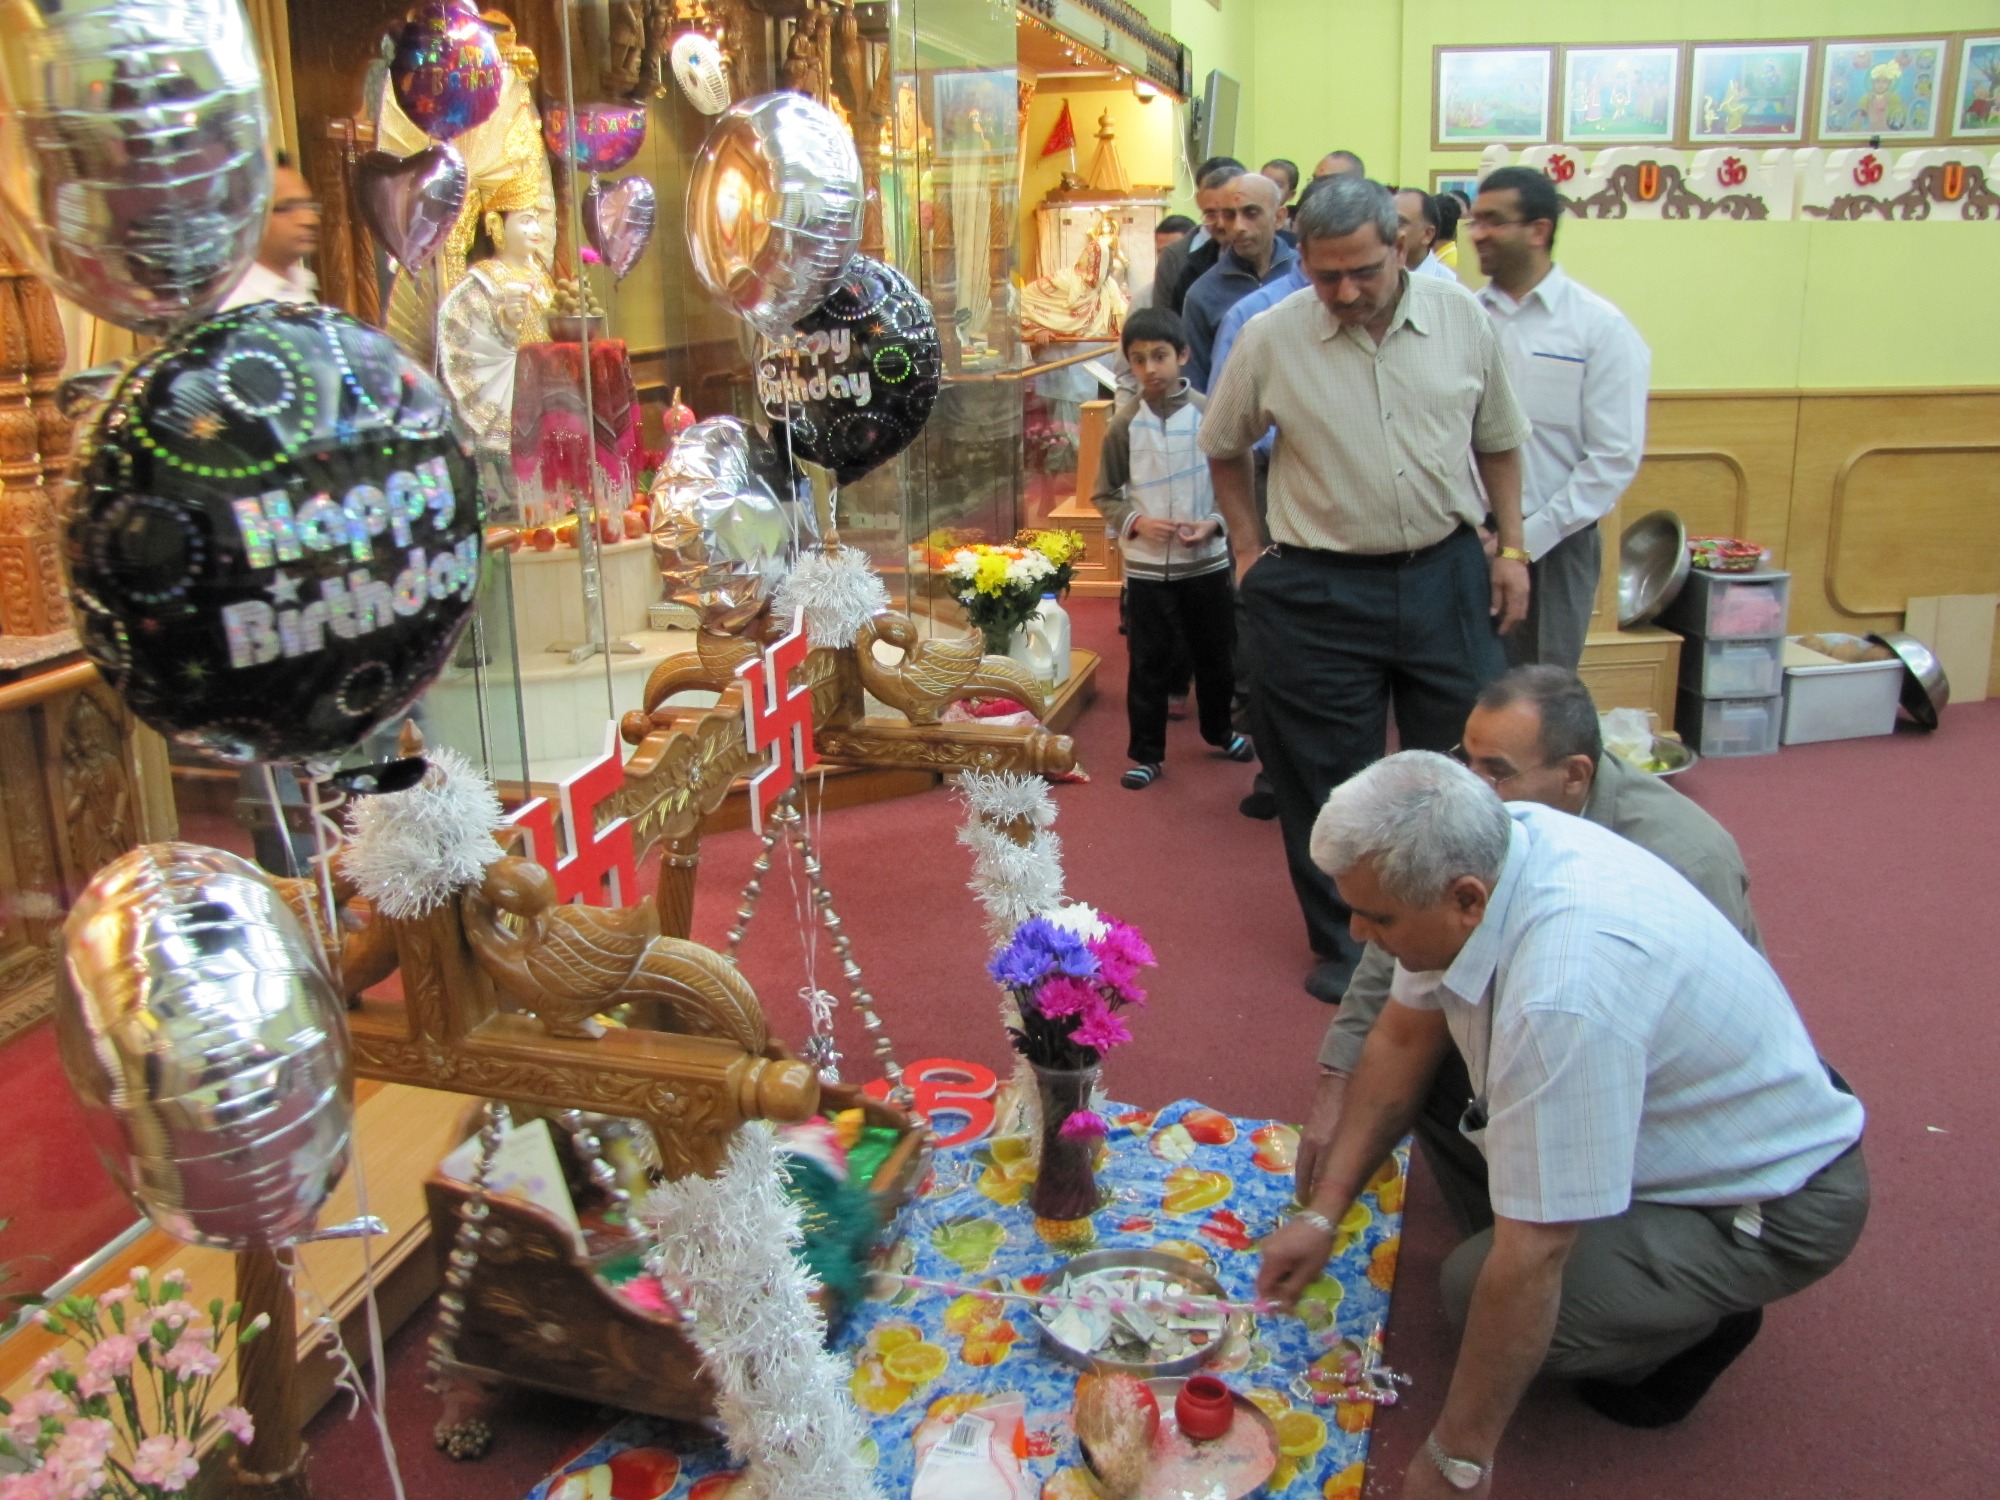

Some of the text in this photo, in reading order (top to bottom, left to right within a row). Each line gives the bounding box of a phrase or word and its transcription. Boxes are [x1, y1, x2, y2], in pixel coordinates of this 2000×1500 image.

[550, 110, 628, 134] BITHDAY
[763, 328, 851, 367] Hpy
[231, 455, 456, 569] Happy
[221, 533, 479, 669] Birthday
